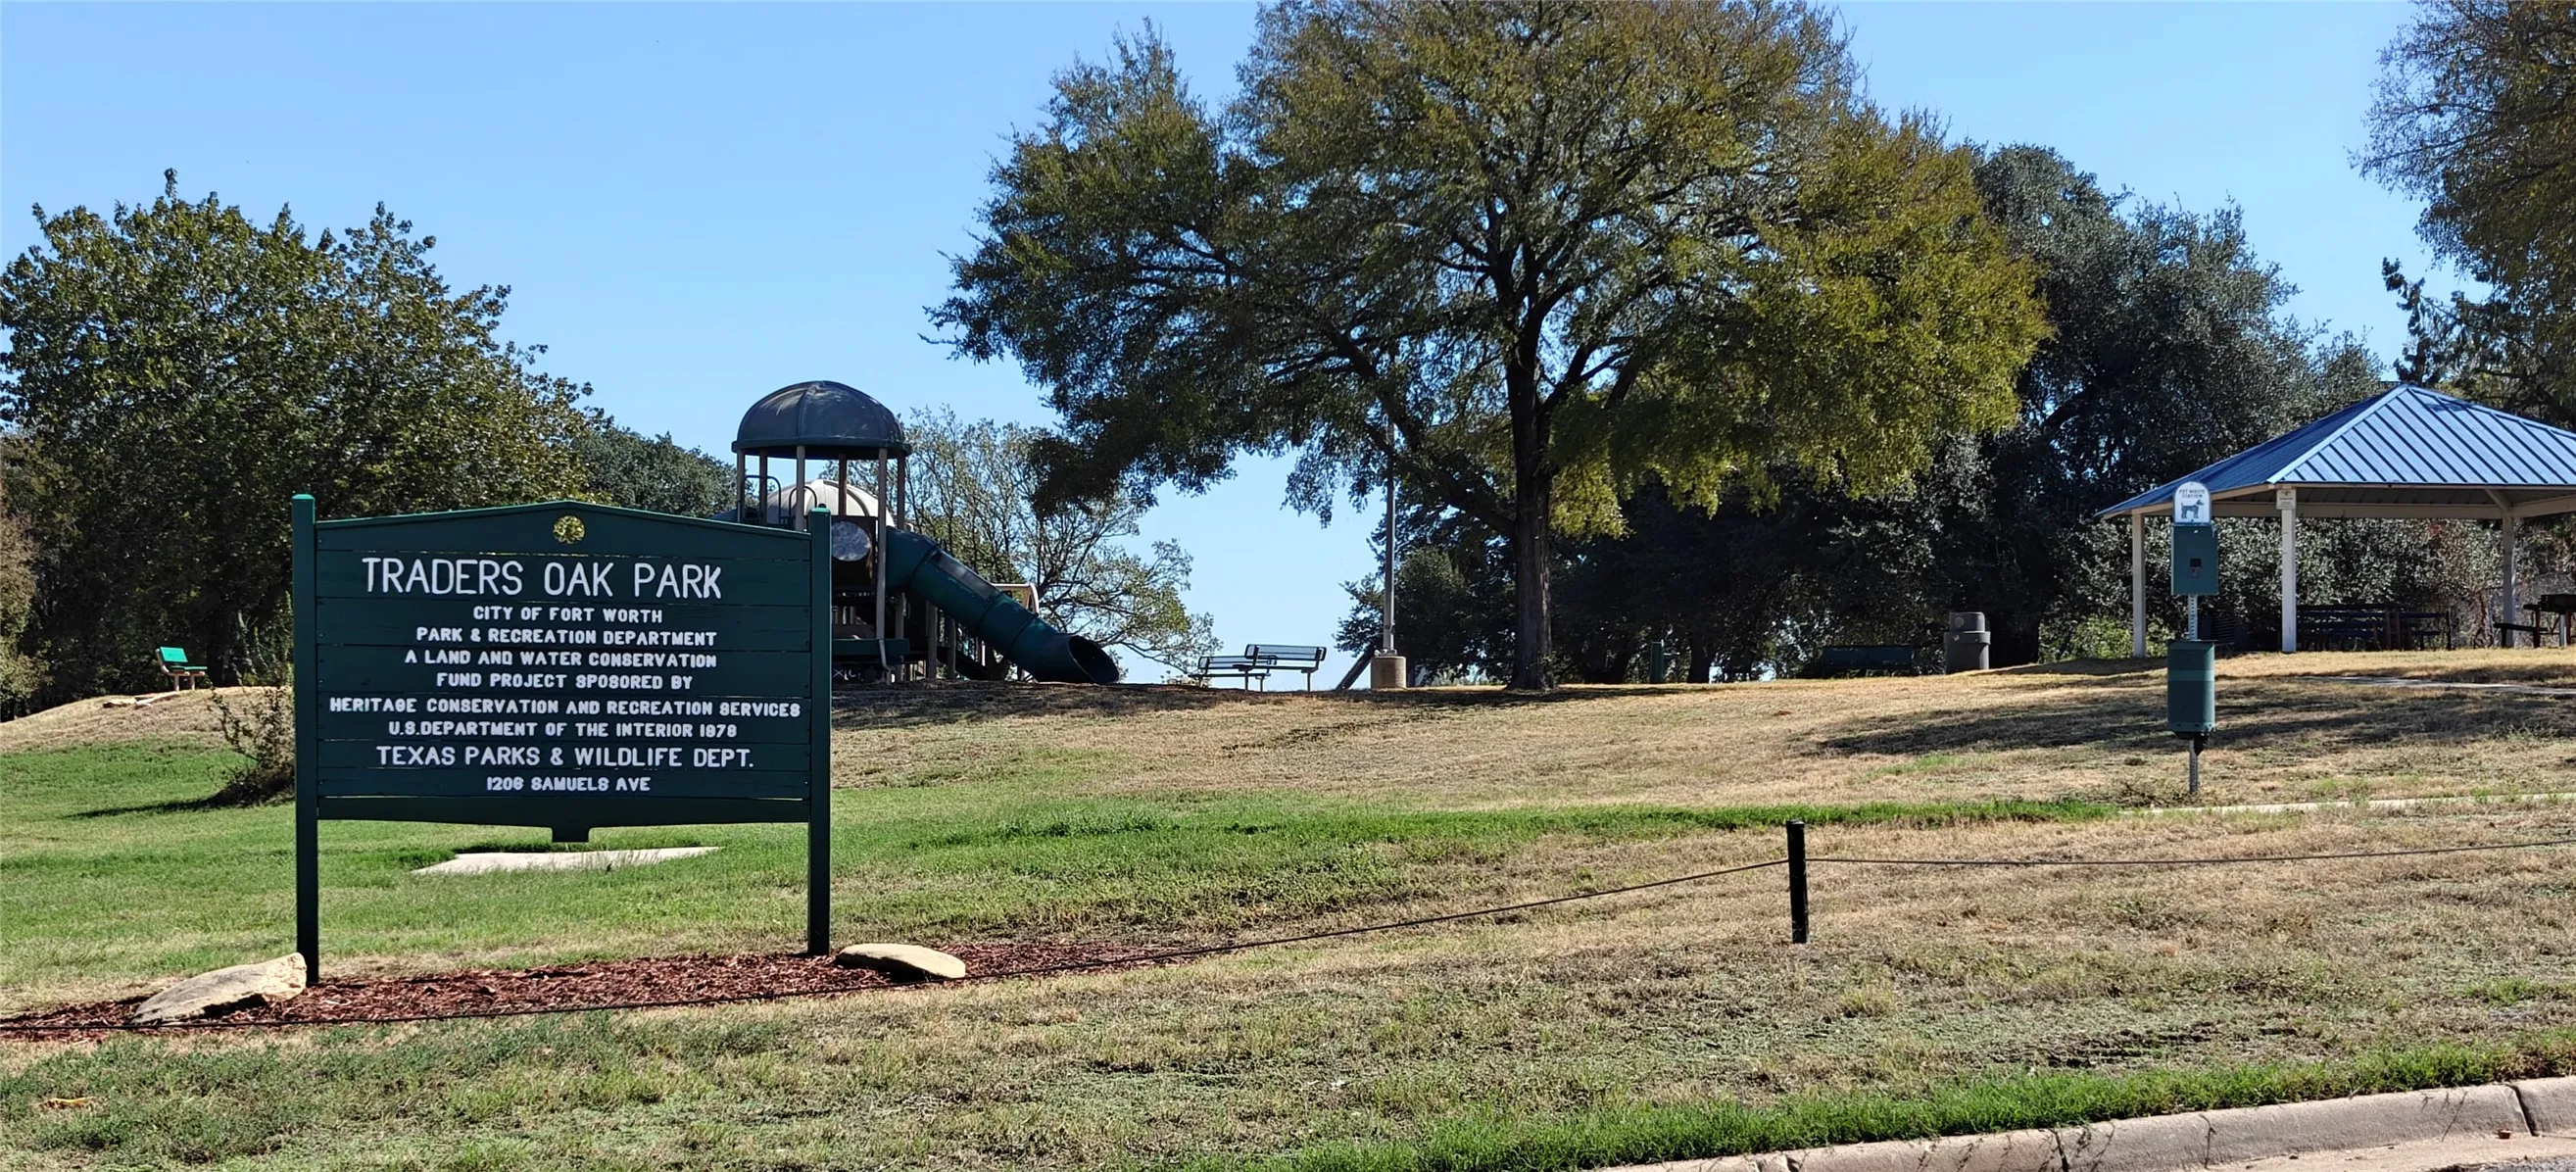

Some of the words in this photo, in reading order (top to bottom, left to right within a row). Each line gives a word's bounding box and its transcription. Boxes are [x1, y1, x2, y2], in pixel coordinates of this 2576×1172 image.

[363, 558, 523, 595] TRADERS
[545, 562, 613, 597] OAK
[635, 563, 721, 599] PARK
[473, 606, 512, 619] CITY
[521, 607, 542, 620] OF
[550, 608, 595, 621] FORT
[603, 609, 661, 623] WORTH
[416, 627, 462, 642] PARK
[470, 628, 481, 642] &
[489, 628, 596, 644] RECREATION
[604, 631, 716, 646] DEPARTMENT
[405, 650, 417, 662] A
[425, 650, 470, 663] LAND
[478, 651, 512, 665] AND
[520, 652, 581, 665] WATER
[589, 653, 716, 667] CONSERVATION
[437, 672, 481, 687] FUND
[490, 673, 566, 688] PROJECT
[576, 674, 662, 689] SPOSORED
[671, 675, 692, 689] BY
[330, 698, 416, 712] HERITAGE
[427, 699, 558, 713] CONSERVATION
[566, 701, 600, 714] AND
[608, 701, 712, 714] RECREATION
[720, 703, 800, 716] SERVICES
[546, 723, 567, 736] OF
[575, 723, 608, 737] THE
[616, 723, 693, 737] INTERIOR
[376, 746, 455, 765] TEXAS
[465, 747, 540, 765] PARKS
[551, 748, 563, 765] &
[575, 748, 682, 766] WILDLIFE
[694, 749, 753, 767] DEPT.
[487, 777, 523, 790] 1206
[531, 777, 608, 791] SAMUELS
[616, 777, 651, 791] AVE
